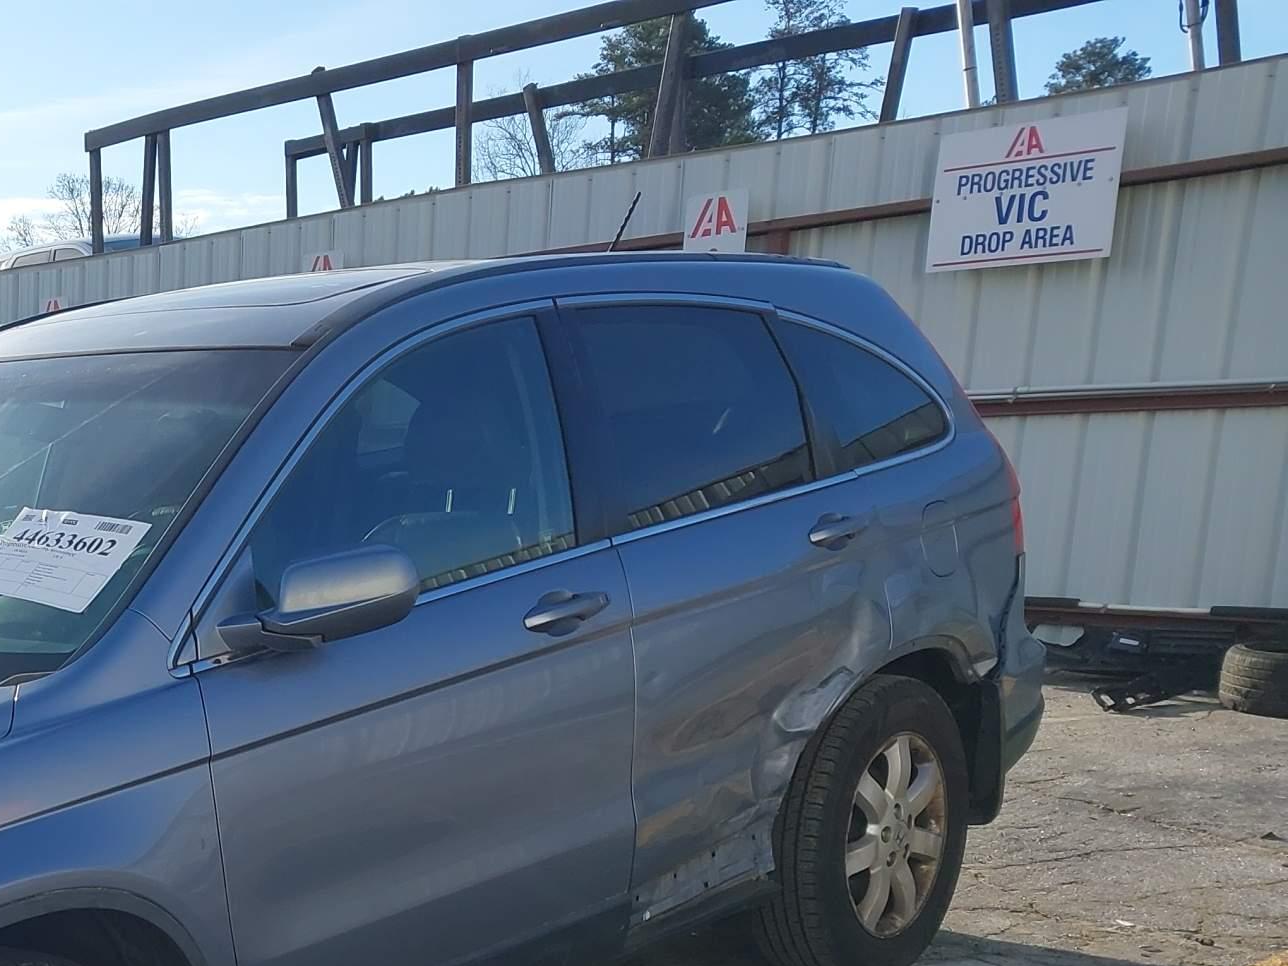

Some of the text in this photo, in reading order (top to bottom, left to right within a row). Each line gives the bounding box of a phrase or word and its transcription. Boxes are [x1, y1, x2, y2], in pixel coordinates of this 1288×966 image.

[956, 158, 1096, 196] PROGRESSIVE
[994, 190, 1049, 225] VIC
[960, 224, 1074, 256] DROP AREA
[13, 528, 118, 557] 44633602
